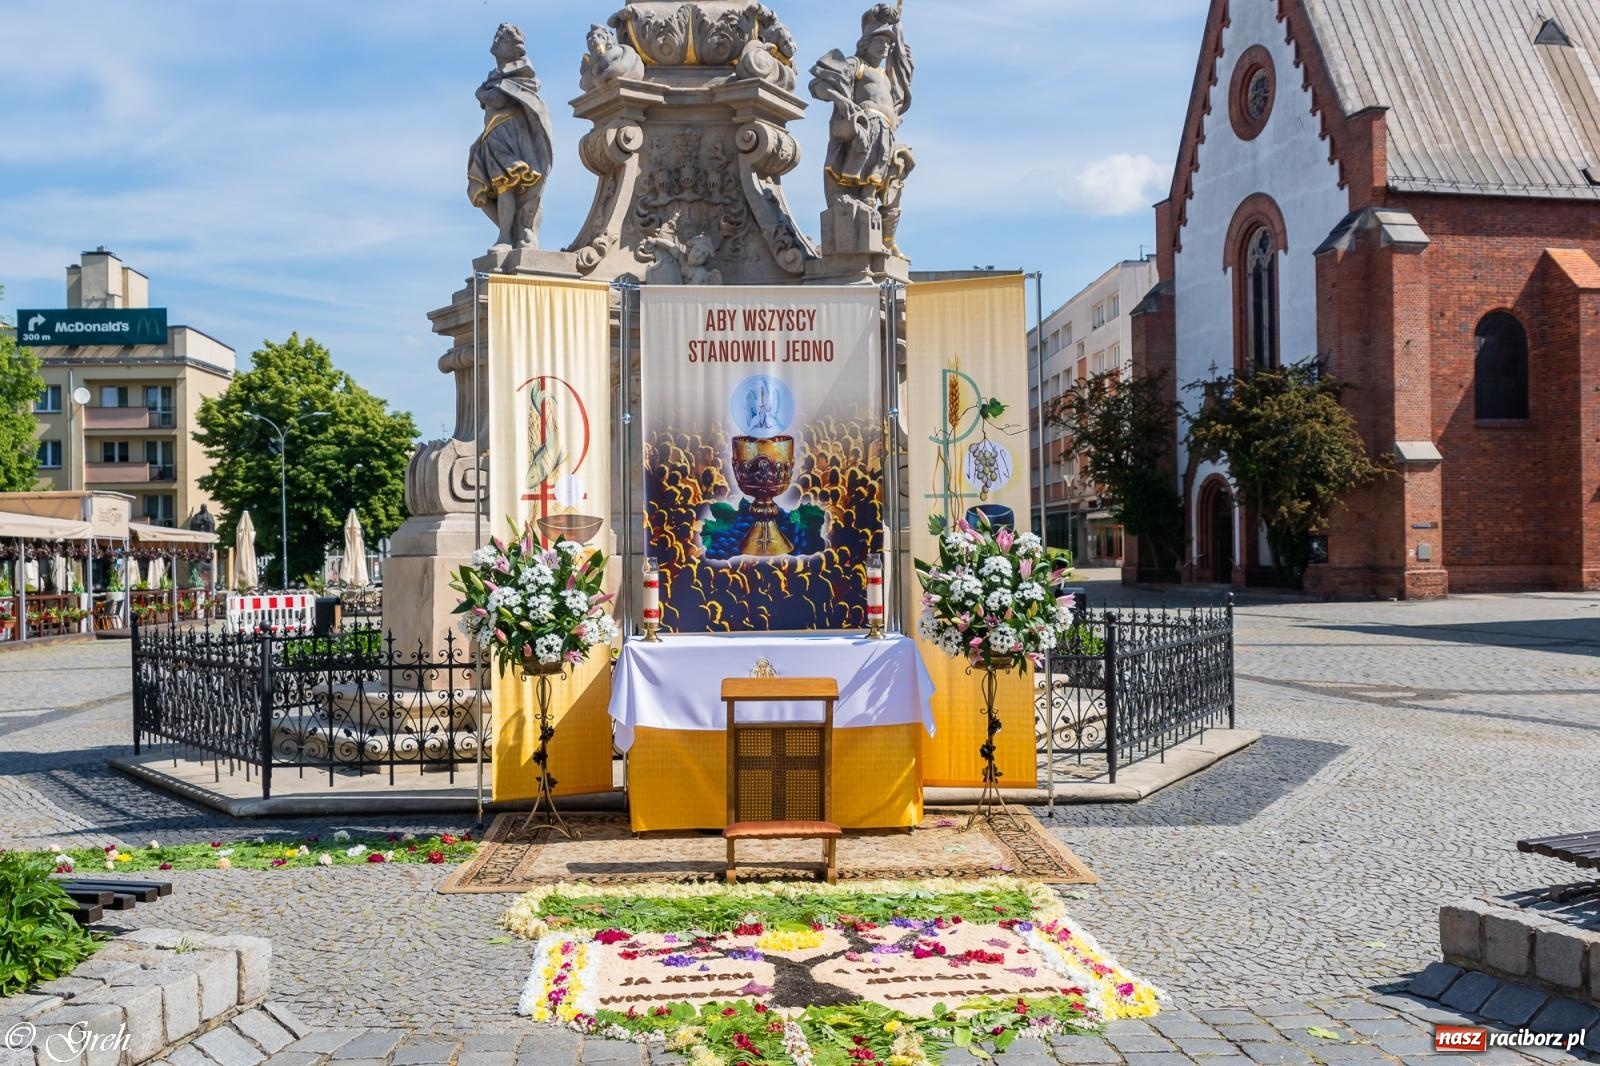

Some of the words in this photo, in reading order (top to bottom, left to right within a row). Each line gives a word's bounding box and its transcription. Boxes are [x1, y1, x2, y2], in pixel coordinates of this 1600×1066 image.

[705, 308, 737, 332] ABY
[743, 308, 816, 332] WSZYSCY
[55, 321, 130, 333] McDonald's
[22, 333, 40, 342] 300
[41, 334, 51, 342] m
[688, 339, 776, 363] STANOWILI
[782, 339, 834, 363] JEDNO
[661, 971, 755, 984] JESTEM
